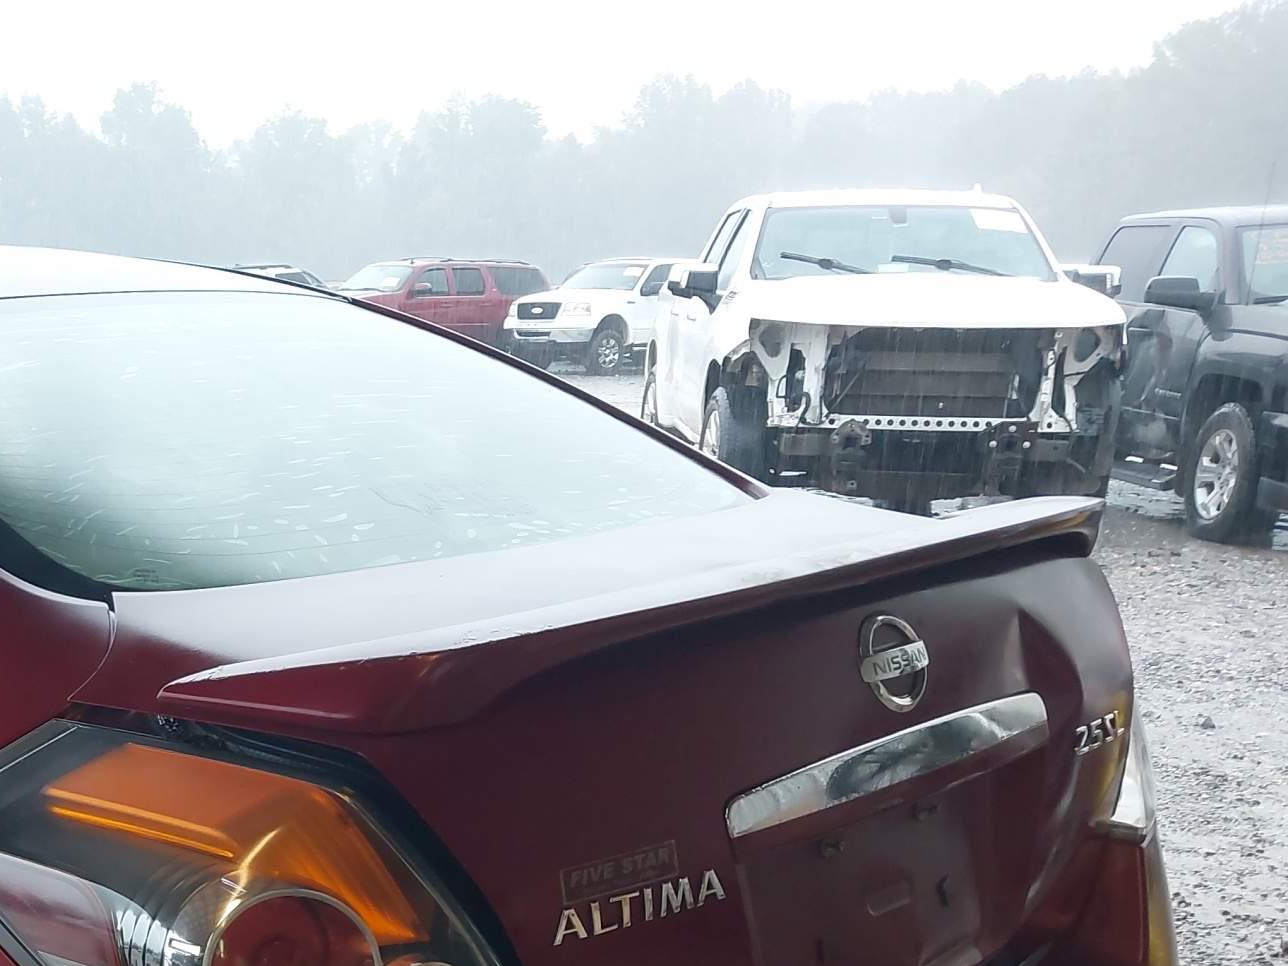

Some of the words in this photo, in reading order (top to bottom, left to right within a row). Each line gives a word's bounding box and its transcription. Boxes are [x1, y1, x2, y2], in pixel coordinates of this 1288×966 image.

[872, 645, 927, 675] NISSAN
[570, 862, 616, 888] FIVE
[621, 846, 670, 874] STAR
[552, 868, 727, 946] ALTIMA
